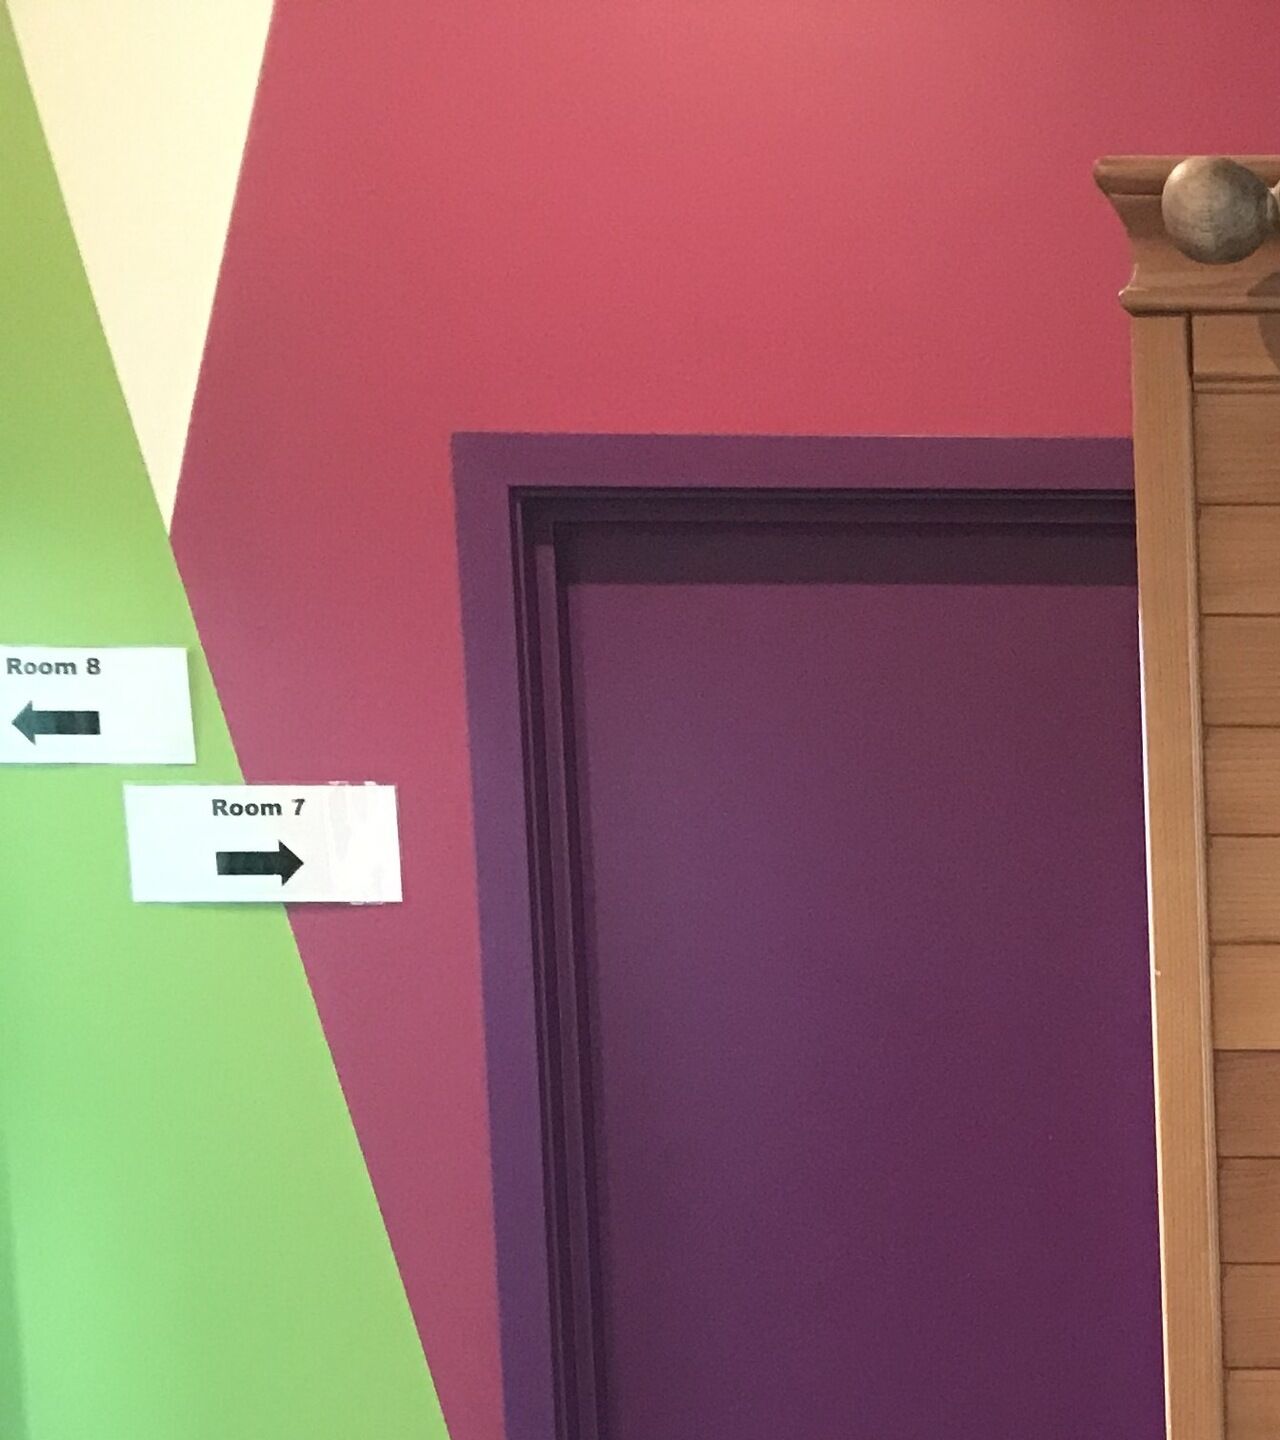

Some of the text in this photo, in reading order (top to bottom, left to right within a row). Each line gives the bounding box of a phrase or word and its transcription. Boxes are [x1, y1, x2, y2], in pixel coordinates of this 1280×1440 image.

[6, 657, 101, 675] Room 8
[211, 799, 305, 816] Room 7
